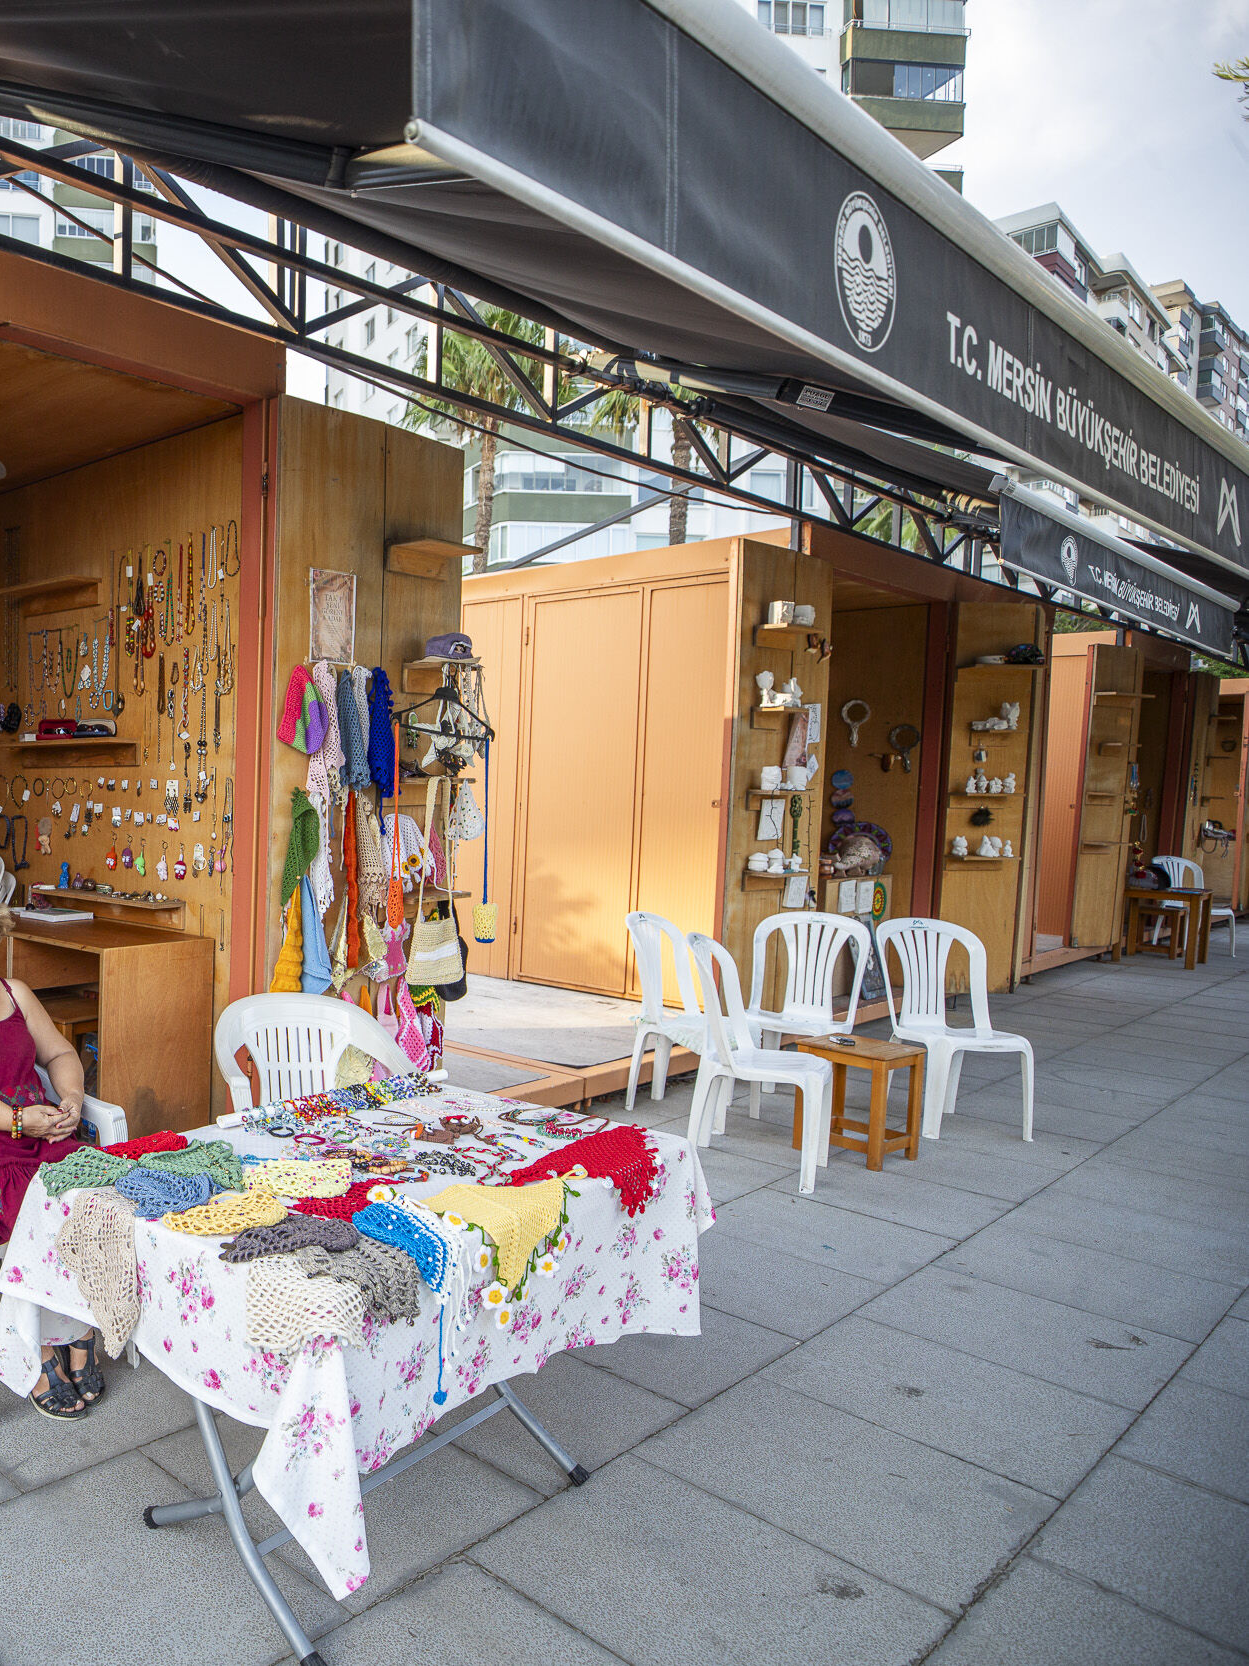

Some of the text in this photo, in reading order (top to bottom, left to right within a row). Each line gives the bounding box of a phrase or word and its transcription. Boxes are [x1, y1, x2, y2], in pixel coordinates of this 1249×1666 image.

[946, 310, 982, 381] T.C.
[987, 339, 1052, 424] MERSİN
[1055, 386, 1139, 481] BÜYÜKŞEHİR
[1139, 447, 1200, 515] BELEDİYESİ
